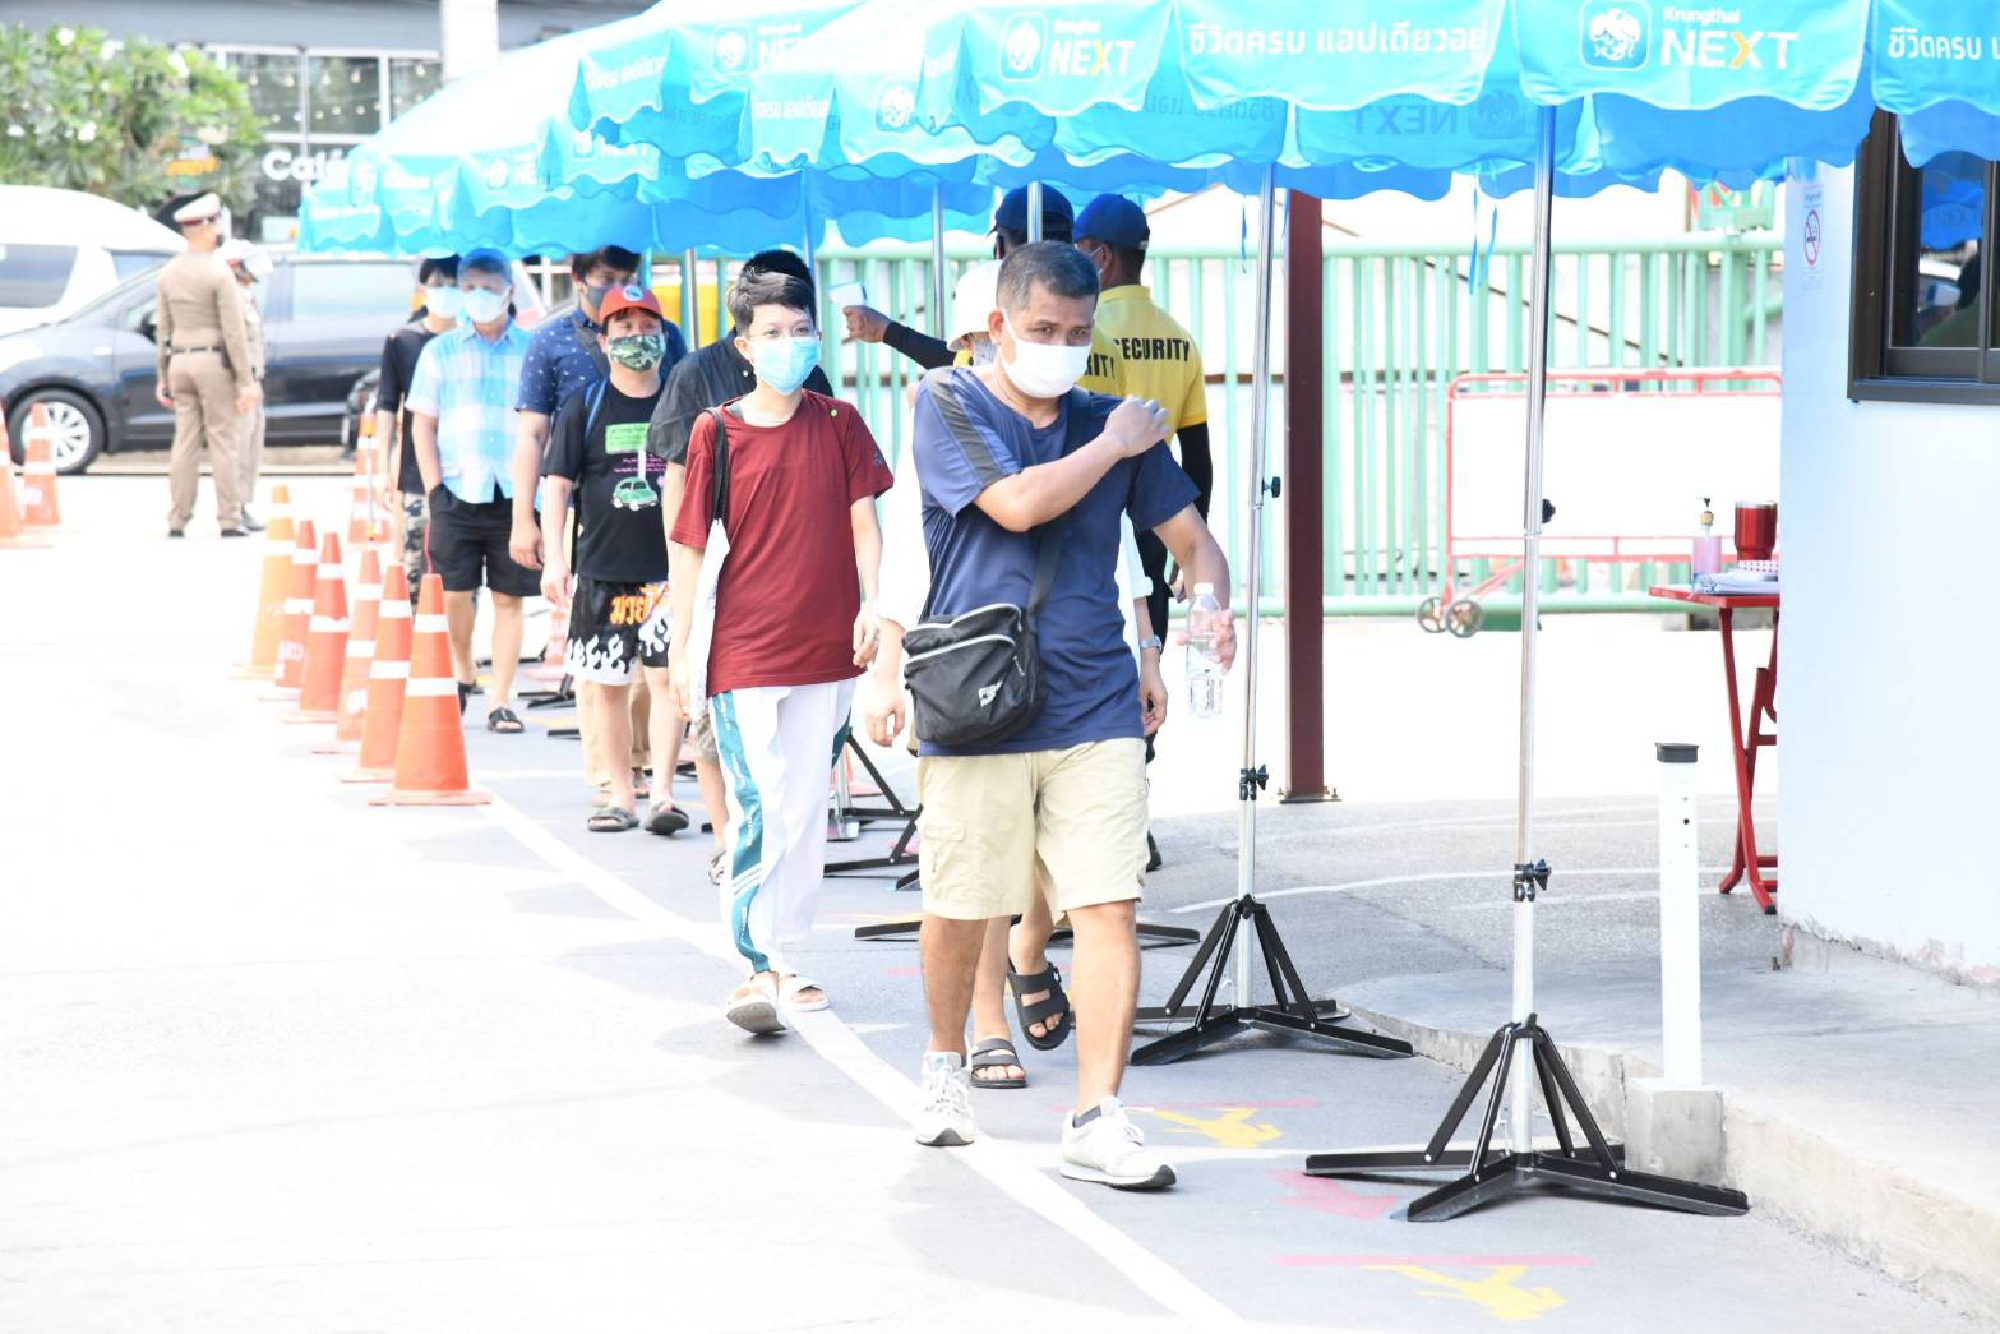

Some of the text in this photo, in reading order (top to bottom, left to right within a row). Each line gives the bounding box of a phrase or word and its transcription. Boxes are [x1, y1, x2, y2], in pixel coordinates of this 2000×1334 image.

[1048, 39, 1137, 76] NEXT
[1660, 28, 1798, 70] NEXT
[1888, 27, 1981, 60] ชีวิตครบ
[1113, 337, 1190, 361] ECURITY
